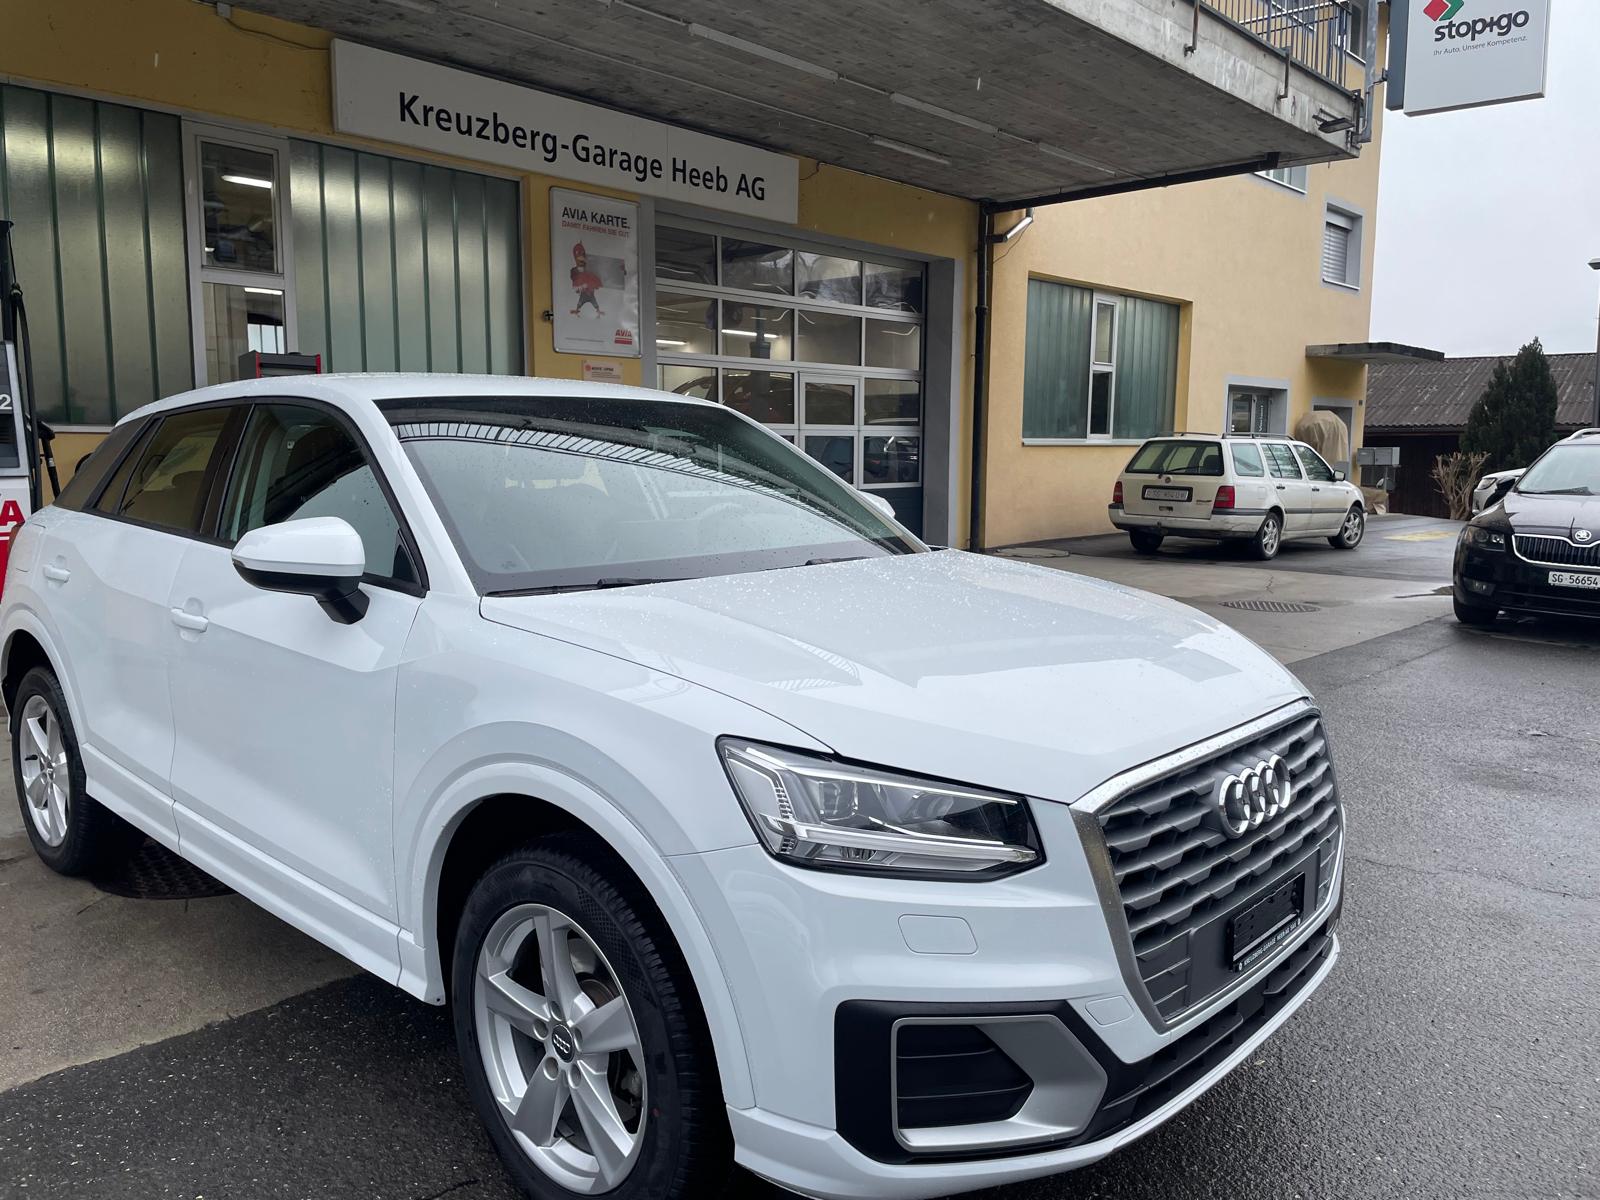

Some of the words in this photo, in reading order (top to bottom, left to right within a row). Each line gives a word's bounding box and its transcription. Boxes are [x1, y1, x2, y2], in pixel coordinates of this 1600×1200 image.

[1462, 42, 1486, 52] Unsere
[399, 91, 663, 183] Kreuzberg-Garage
[672, 157, 728, 193] Heeb
[736, 173, 765, 201] AG
[562, 206, 588, 222] AVIA
[590, 211, 631, 230] KARTE.
[615, 328, 633, 338] AVIA
[1551, 573, 1564, 583] SG
[1568, 575, 1599, 586] 56654
